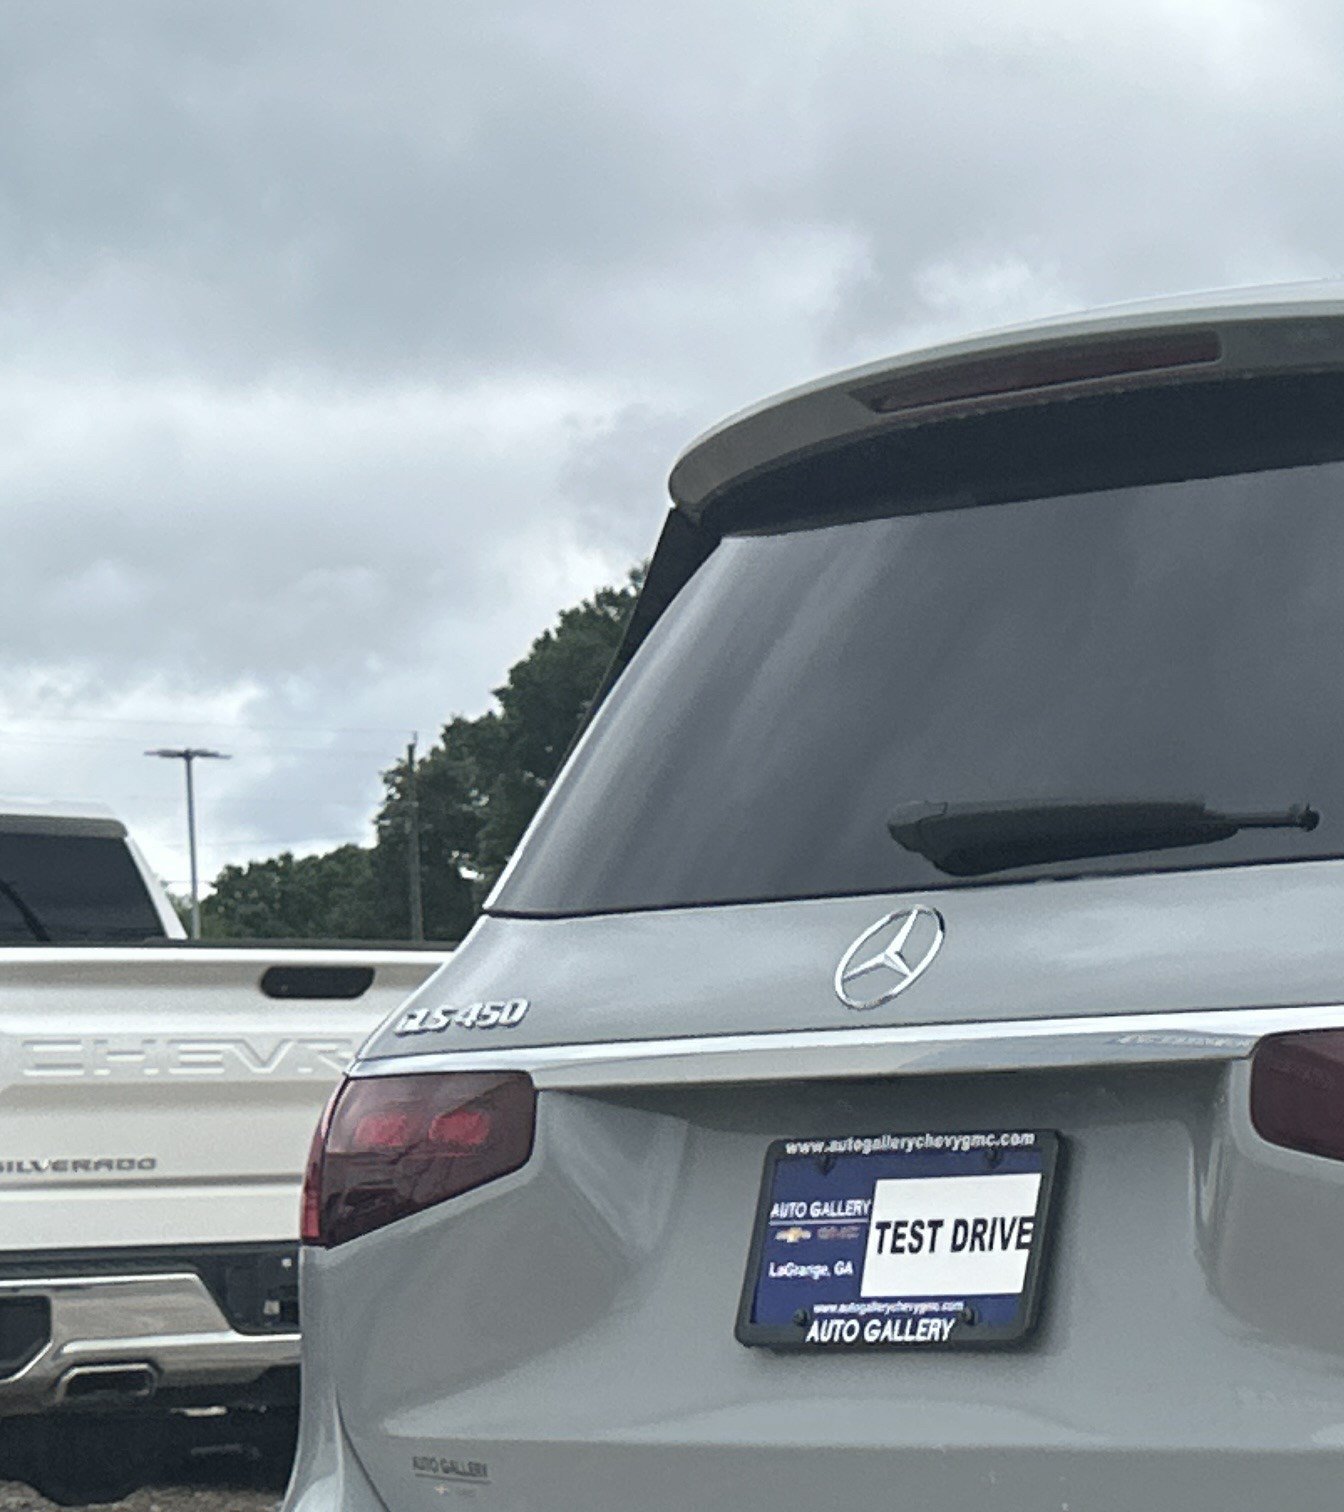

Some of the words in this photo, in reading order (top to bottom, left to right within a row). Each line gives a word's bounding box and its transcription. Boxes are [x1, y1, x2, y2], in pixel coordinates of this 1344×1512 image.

[786, 1133, 1036, 1155] www.autogallerychevygmc.com
[0, 1157, 157, 1173] ILVERADO
[770, 1201, 808, 1218] AUTO
[809, 1199, 871, 1218] GALLERY
[875, 1218, 945, 1254] TEST
[949, 1215, 1035, 1252] DRIVE
[768, 1262, 831, 1280] LaGrange,
[833, 1260, 854, 1276] GA
[805, 1318, 860, 1343] AUTO
[863, 1317, 956, 1342] GALLERY
